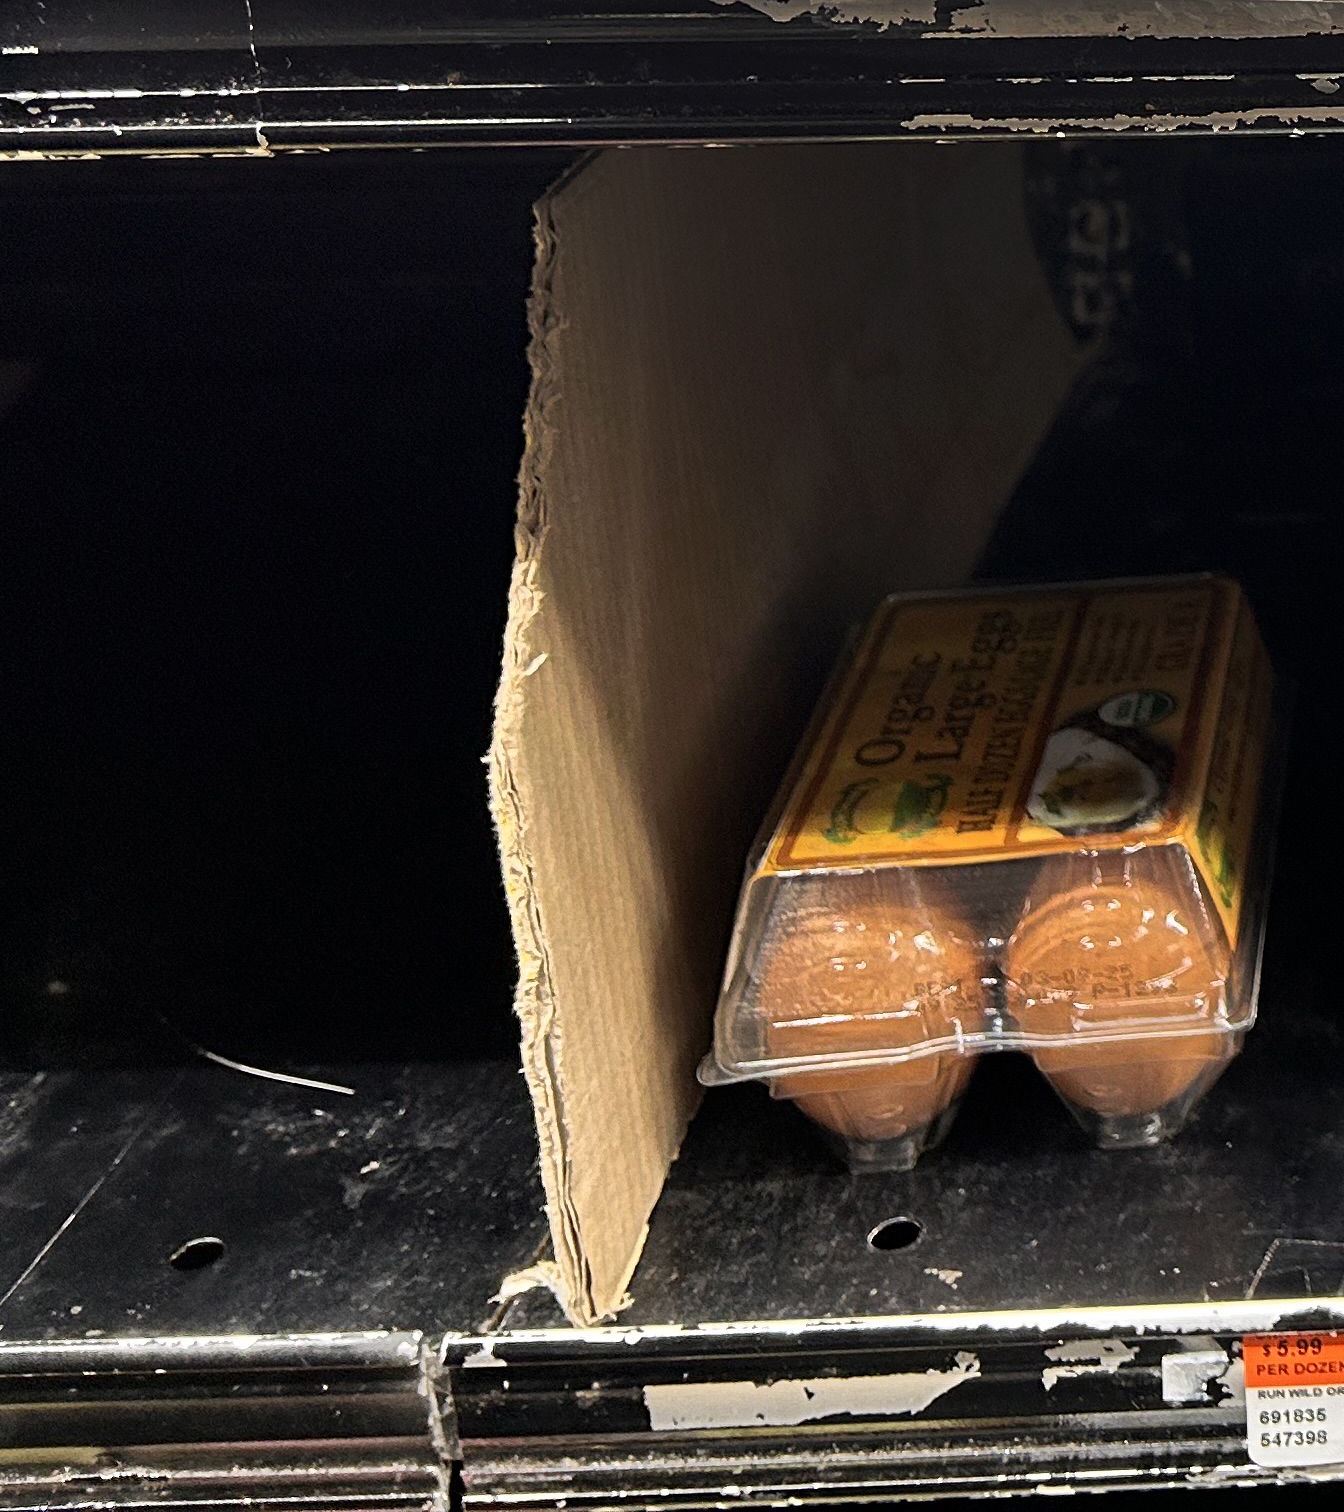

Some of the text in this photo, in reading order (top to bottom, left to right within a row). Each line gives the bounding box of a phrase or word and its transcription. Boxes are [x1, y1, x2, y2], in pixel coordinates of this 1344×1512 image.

[855, 652, 942, 766] Organic
[913, 676, 995, 762] Large
[1277, 1338, 1322, 1357] 5.99
[1257, 1364, 1289, 1376] PER
[1258, 1389, 1285, 1399] RUN
[1288, 1388, 1322, 1398] WILD
[1260, 1407, 1326, 1425] 691835
[1260, 1430, 1328, 1448] 547398
